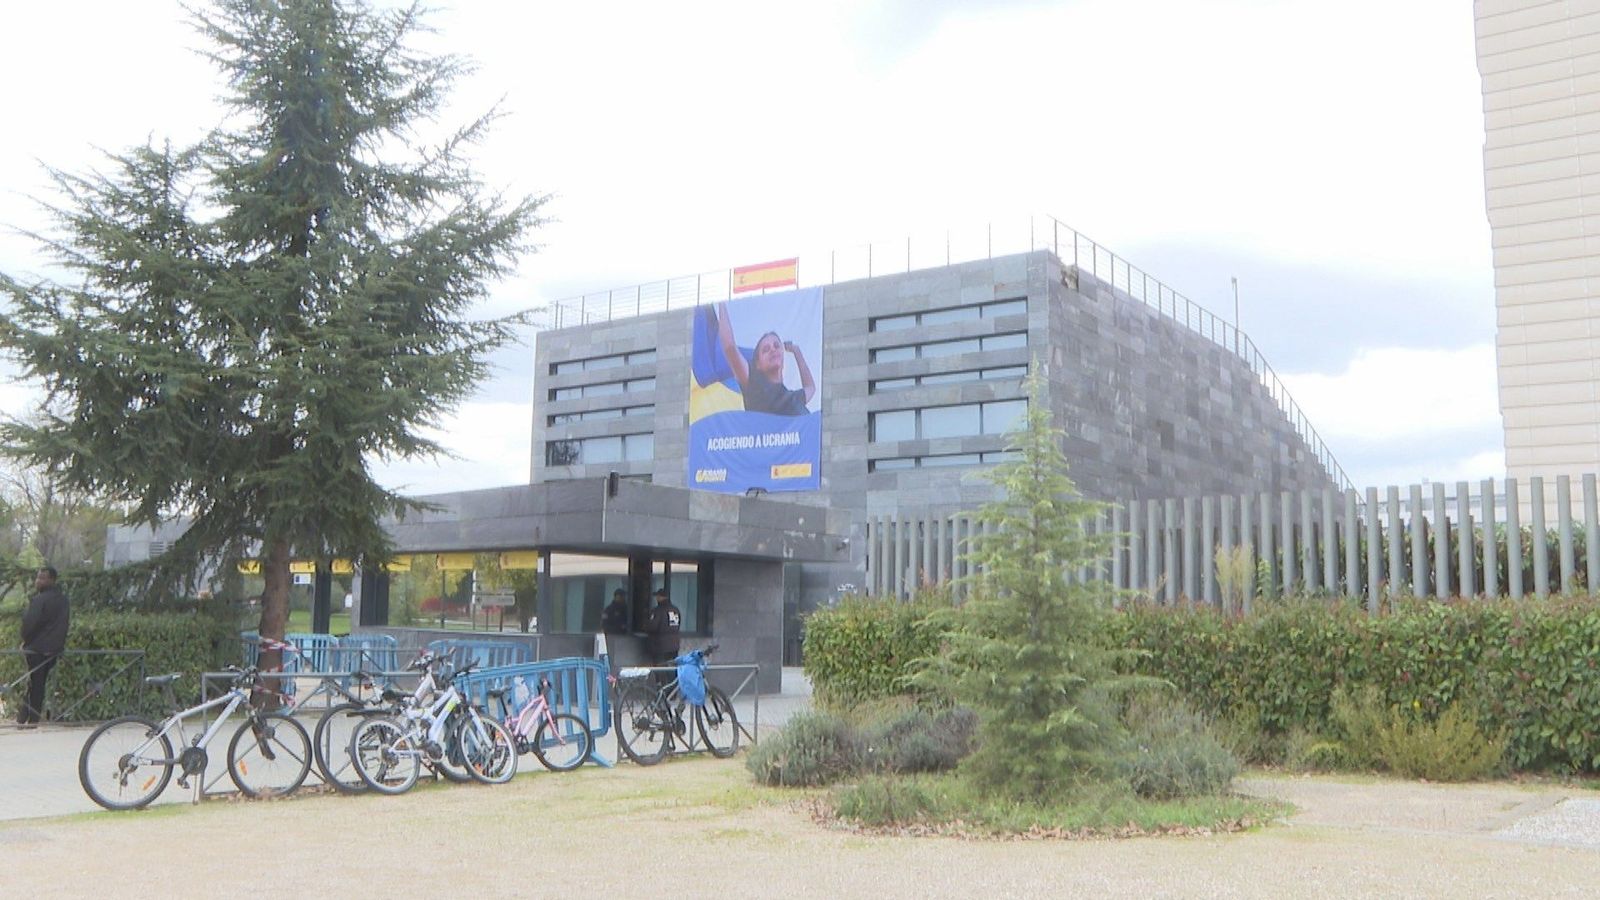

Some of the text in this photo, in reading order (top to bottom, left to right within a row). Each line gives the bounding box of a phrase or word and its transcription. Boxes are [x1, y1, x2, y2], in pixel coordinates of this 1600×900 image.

[707, 432, 800, 451] ACOGIENDO A UCRANIA
